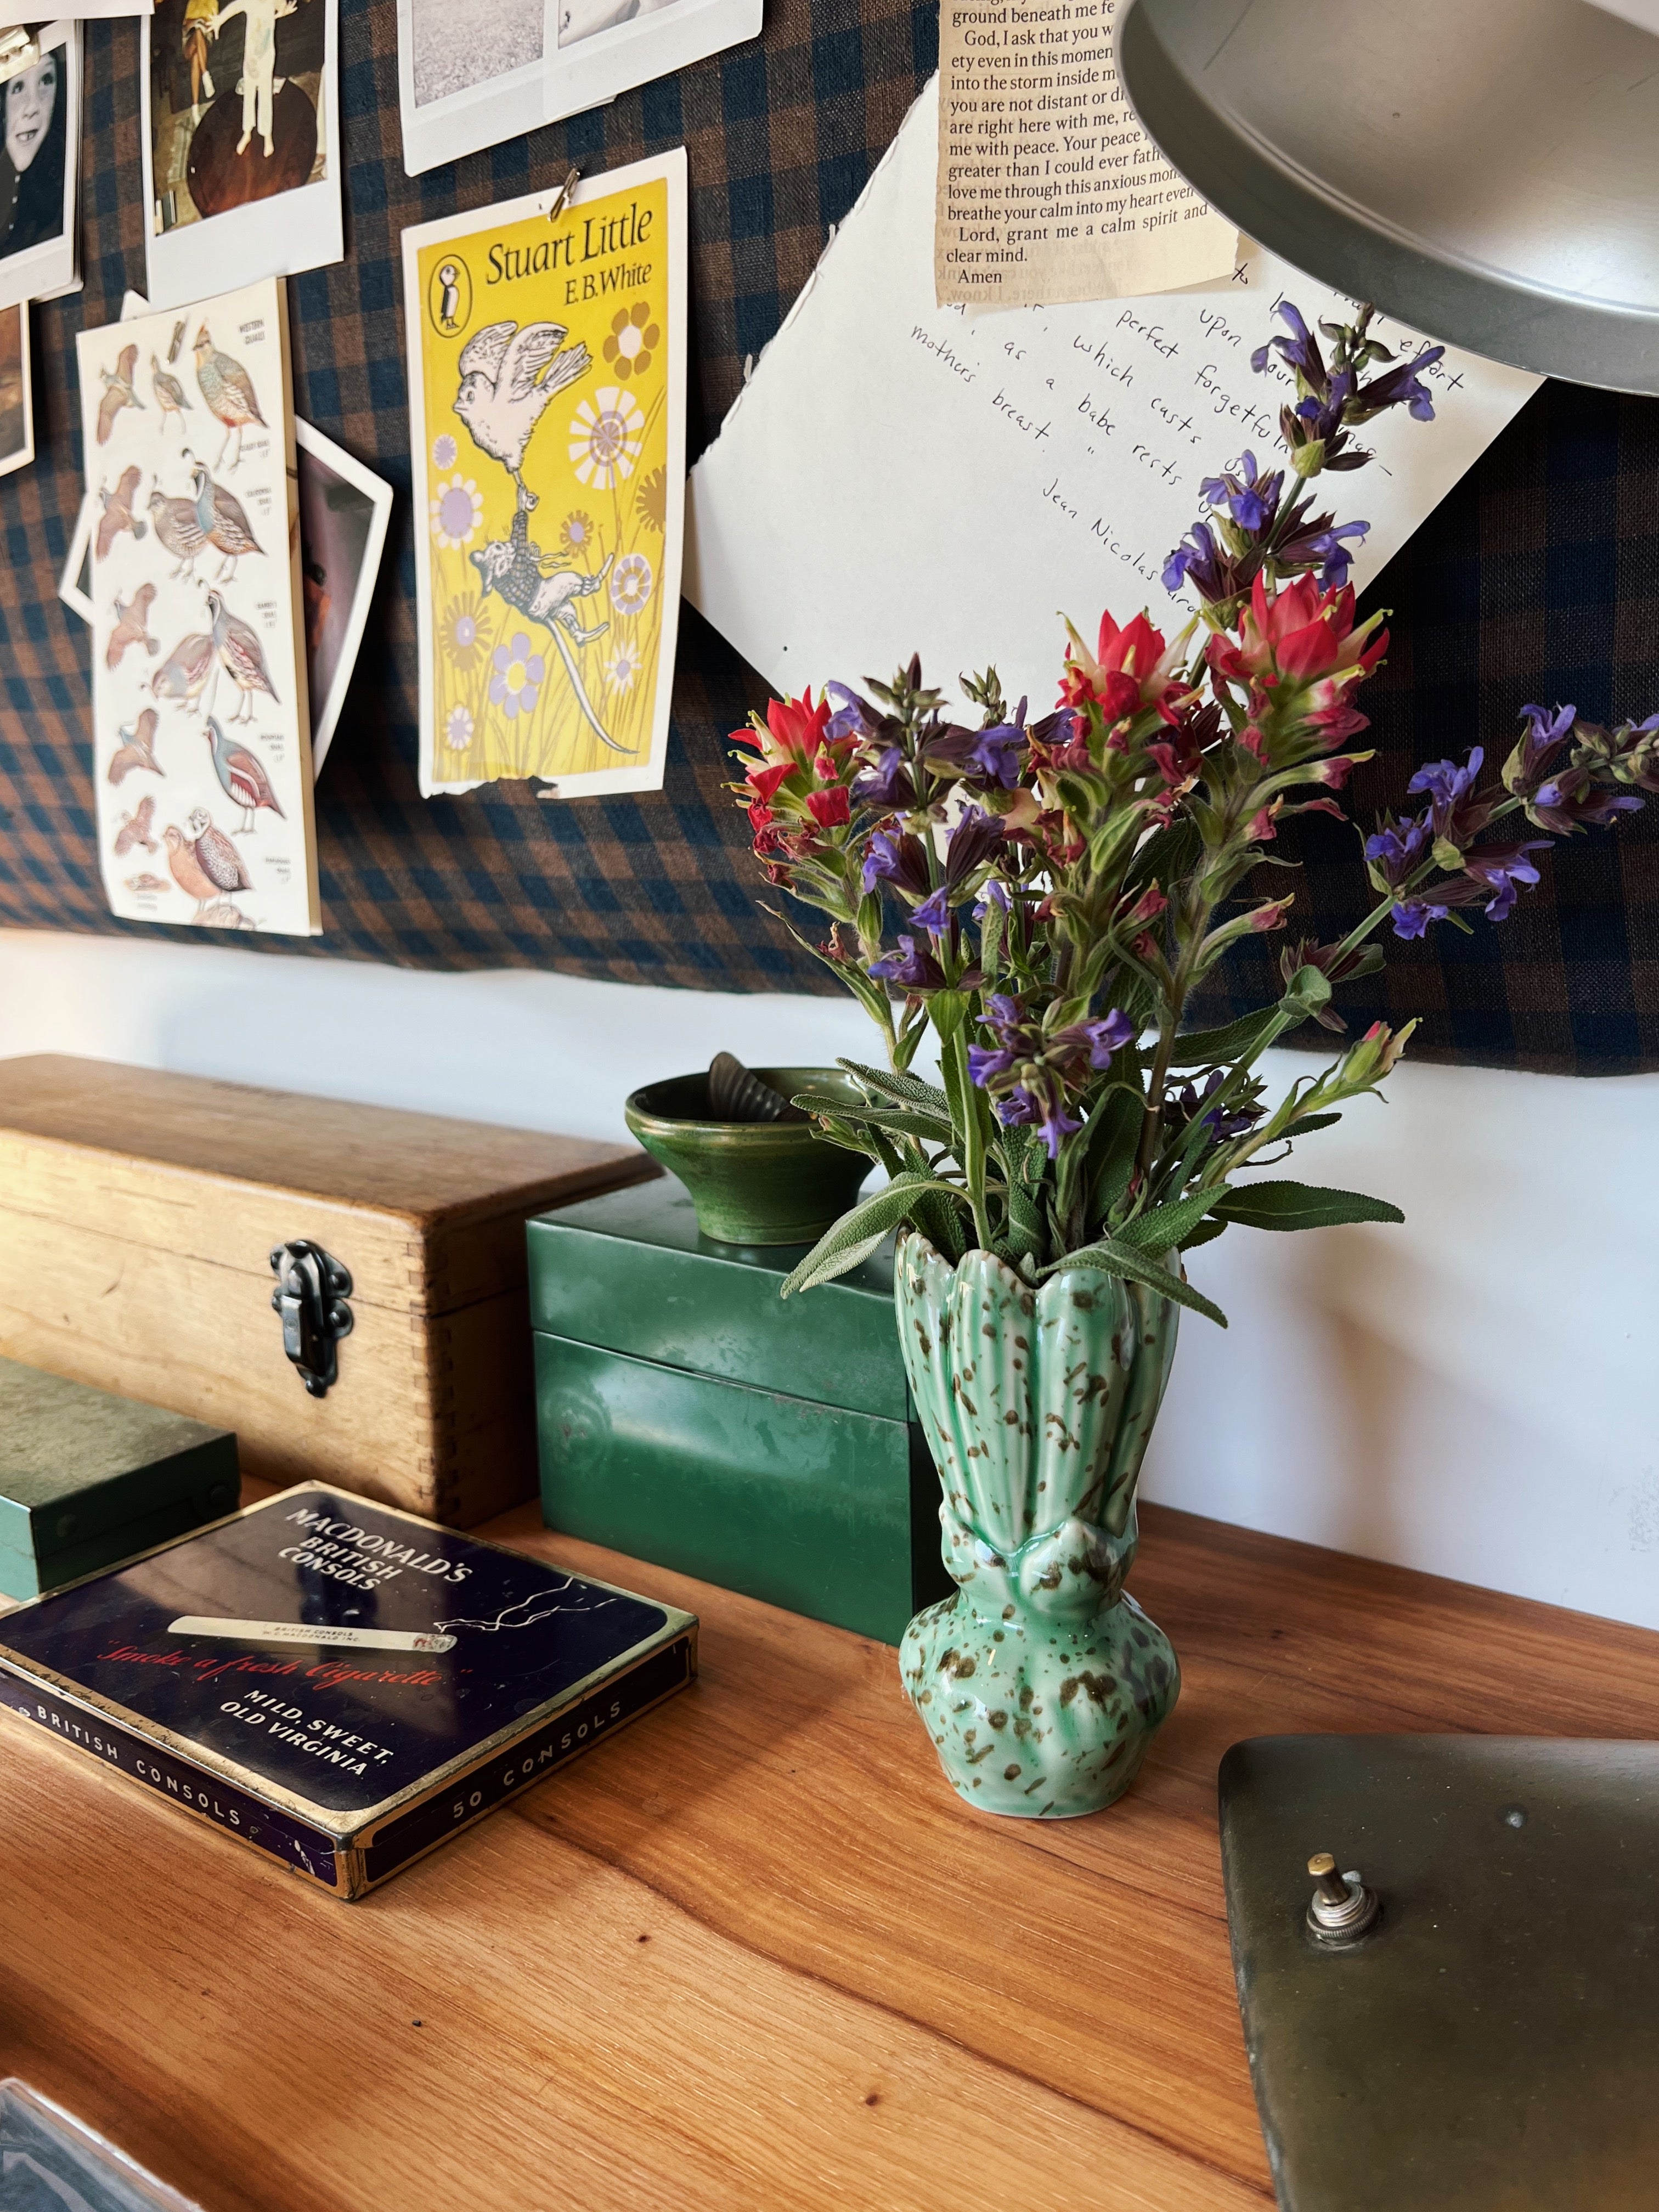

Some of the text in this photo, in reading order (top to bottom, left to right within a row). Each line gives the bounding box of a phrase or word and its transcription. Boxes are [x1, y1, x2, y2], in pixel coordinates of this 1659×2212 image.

[952, 9, 1006, 27] ground
[1012, 5, 1070, 23] beneath
[1075, 5, 1097, 18] me
[964, 30, 1000, 48] God,
[1003, 30, 1008, 45] I
[1012, 29, 1036, 45] ask
[1040, 27, 1069, 43] that
[1072, 26, 1098, 44] you
[952, 47, 1113, 72] ety even in this momen
[951, 76, 979, 90] into
[984, 75, 1007, 90] the
[1010, 76, 1053, 89] storm
[1057, 68, 1099, 87] inside
[951, 101, 977, 116] you
[981, 99, 1005, 112] are
[1009, 98, 1033, 112] not
[1037, 92, 1087, 111] distant
[1092, 92, 1107, 105] or
[950, 122, 973, 134] are
[978, 119, 1013, 138] right
[1018, 118, 1051, 133] here
[1056, 113, 1088, 130] with
[1093, 114, 1119, 126] me,
[949, 145, 972, 156] me
[975, 141, 1009, 156] with
[1013, 142, 1059, 159] peace.
[1063, 136, 1097, 152] Your
[1101, 131, 1141, 152] peace
[949, 145, 1160, 182] greater than I could ever fath
[949, 184, 977, 199] love
[980, 188, 1001, 199] me
[1005, 181, 1062, 201] through
[1065, 179, 1091, 194] this
[1094, 174, 1147, 191] anxious
[947, 206, 1001, 220] breathe
[1005, 209, 1036, 223] your
[1040, 202, 1073, 217] calm
[1076, 201, 1103, 215] into
[1105, 199, 1127, 214] my
[1130, 192, 1163, 209] heart
[960, 227, 1000, 242] Lord,
[1007, 228, 1048, 245] grant
[1056, 225, 1079, 238] me
[1086, 225, 1093, 235] a
[1101, 218, 1136, 233] calm
[1143, 210, 1178, 232] spirit
[1184, 203, 1207, 219] and
[486, 202, 652, 285] Stuart Little
[947, 247, 1027, 262] clear mind.
[958, 269, 1002, 284] Amen
[1200, 309, 1241, 347] upon
[1116, 310, 1178, 358] perfect
[1194, 364, 1288, 454] forgetfuln
[1400, 339, 1464, 391] efort
[1074, 336, 1133, 387] which
[1152, 398, 1201, 443] casts
[1005, 342, 1181, 485] as a babe rests
[1043, 478, 1077, 519] Jean
[1091, 518, 1158, 580] Nicolas
[285, 1509, 473, 1582] MACDONALD'S
[300, 1537, 403, 1580] BRITISH
[279, 1547, 381, 1590] CONSOLS
[194, 1658, 218, 1668] a
[196, 1655, 303, 1681] fresh
[220, 1701, 367, 1775] OLD VIRGINIA
[244, 1690, 394, 1764] MILD, SWEET,
[37, 1705, 240, 1826] BRITISH CONSOLS
[453, 1701, 620, 1818] 50 CONSOLS
